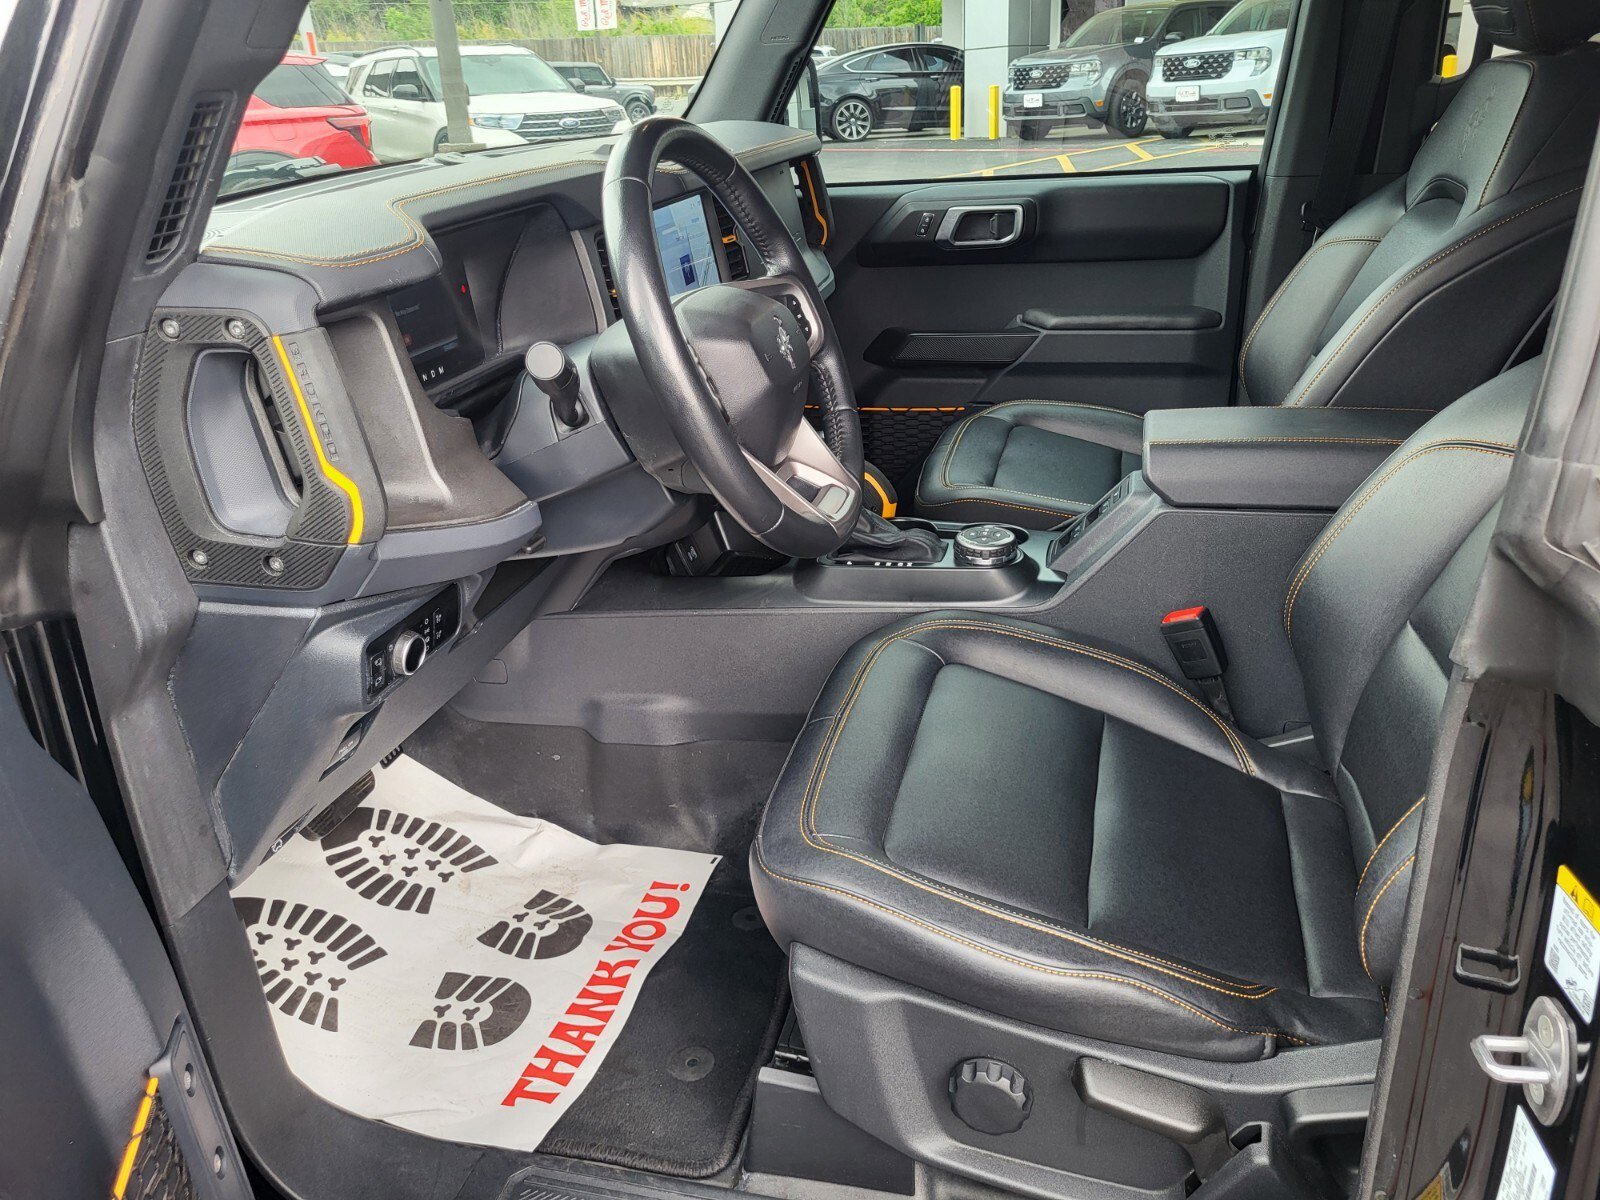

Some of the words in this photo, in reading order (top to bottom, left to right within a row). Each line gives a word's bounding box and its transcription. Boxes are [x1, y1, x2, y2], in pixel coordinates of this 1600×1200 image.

[288, 341, 340, 461] BRONCO
[422, 373, 428, 382] N
[430, 369, 436, 378] D
[500, 959, 642, 1107] THANK
[603, 880, 691, 953] YOU!
